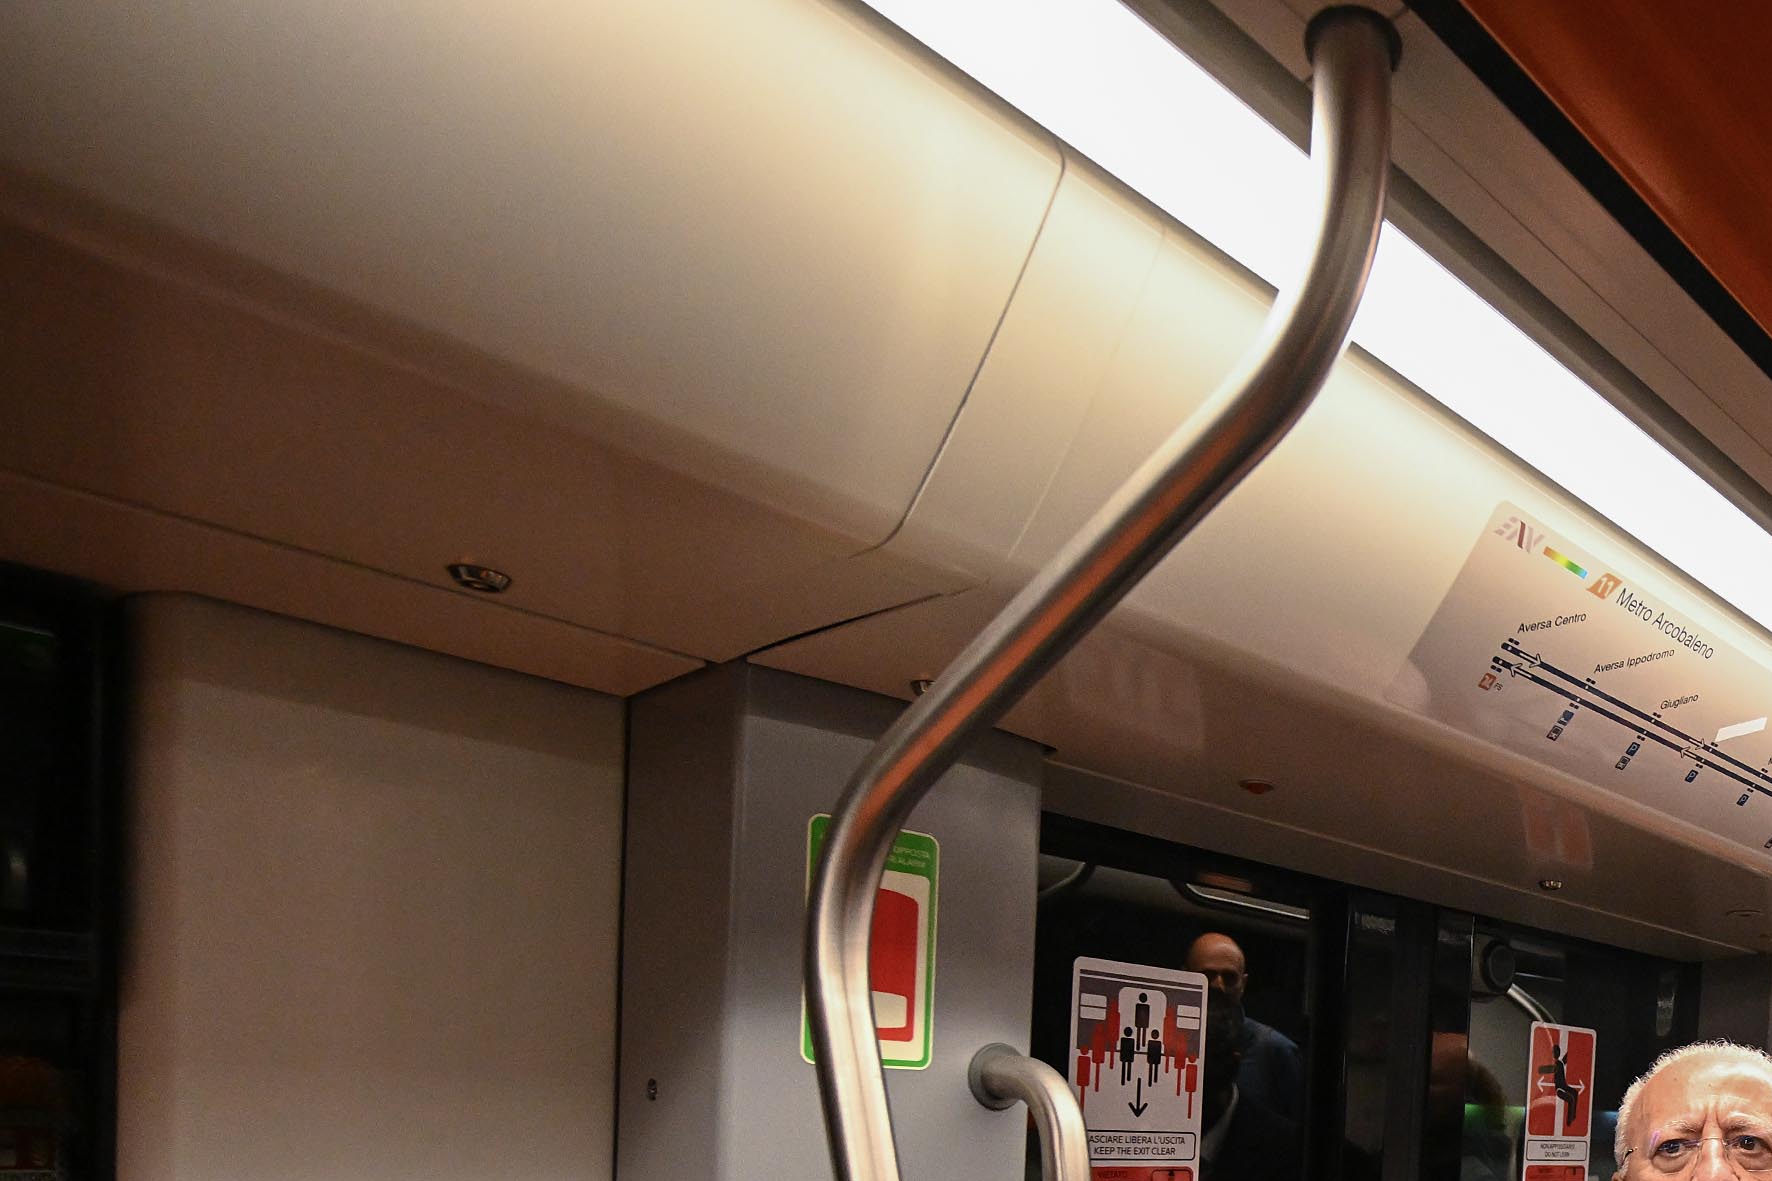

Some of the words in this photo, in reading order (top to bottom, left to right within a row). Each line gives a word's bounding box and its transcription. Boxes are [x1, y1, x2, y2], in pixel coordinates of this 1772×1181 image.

[1518, 619, 1552, 633] Aversa
[1554, 612, 1587, 626] Centro
[1616, 588, 1653, 622] Metro
[1652, 612, 1714, 660] Arcobaleno
[1594, 659, 1625, 674] Aversa
[1627, 649, 1675, 668] Ippodromo
[1660, 693, 1699, 711] Giugliano
[1089, 1135, 1123, 1144] ASCIARE
[1125, 1136, 1152, 1144] LIBERA
[1153, 1136, 1185, 1145] L'USCITA
[1093, 1147, 1115, 1155] KEEP
[1116, 1147, 1131, 1155] THE
[1133, 1147, 1150, 1156] EXIT
[1151, 1147, 1176, 1156] CLEAR
